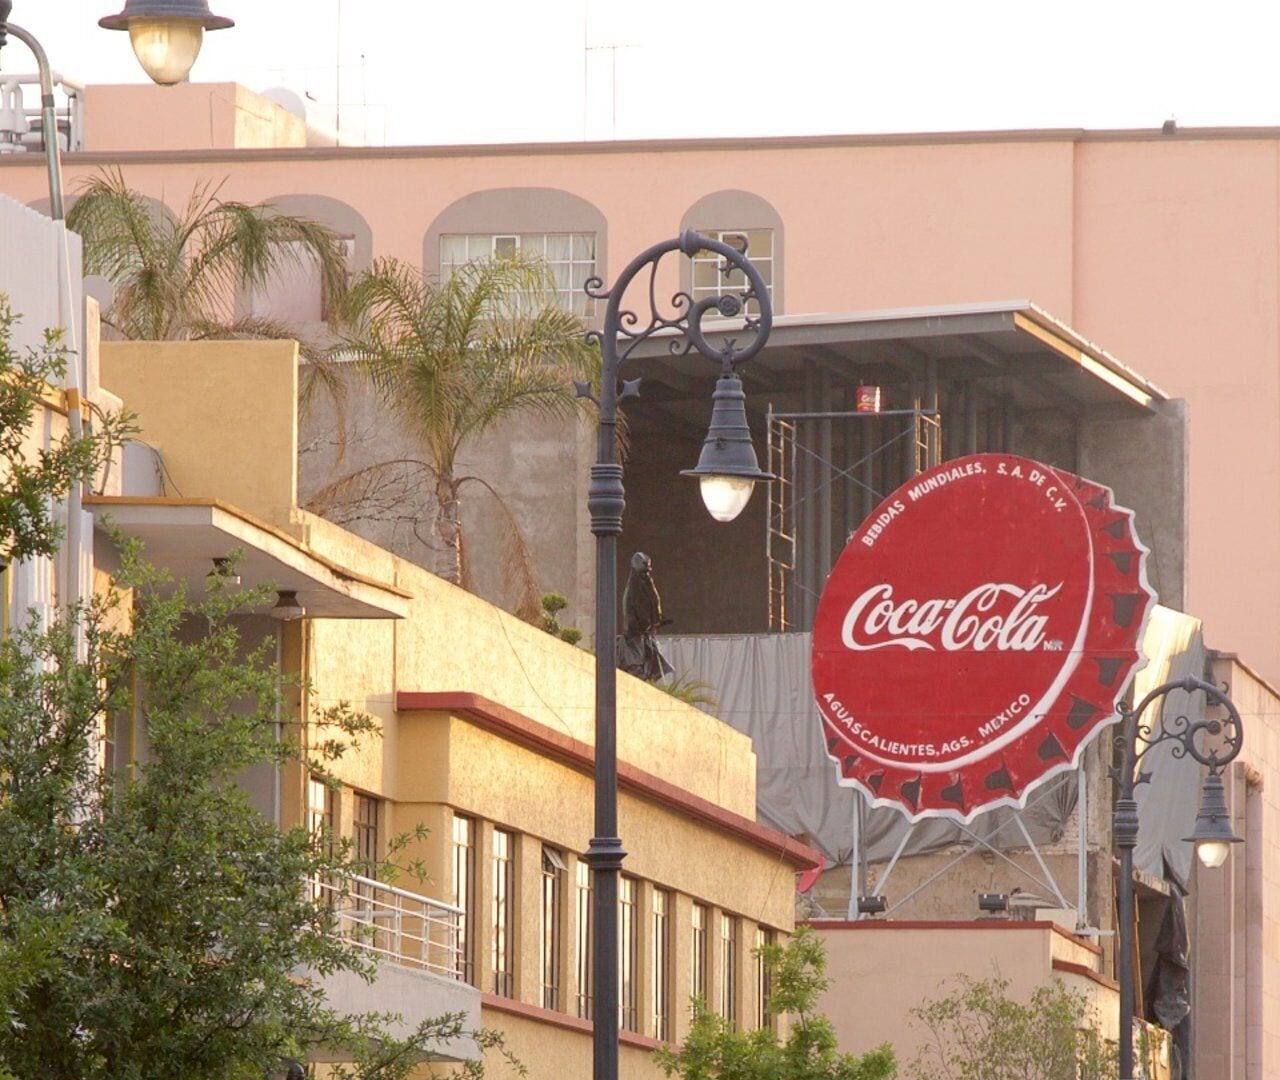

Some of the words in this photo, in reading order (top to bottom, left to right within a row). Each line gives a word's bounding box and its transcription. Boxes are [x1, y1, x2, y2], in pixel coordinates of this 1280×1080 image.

[861, 500, 905, 547] BEBIDAS
[1029, 469, 1047, 486] DE
[1046, 486, 1067, 512] C.V.
[841, 581, 1064, 651] Coca-Cola
[978, 694, 1030, 738] MEXICO
